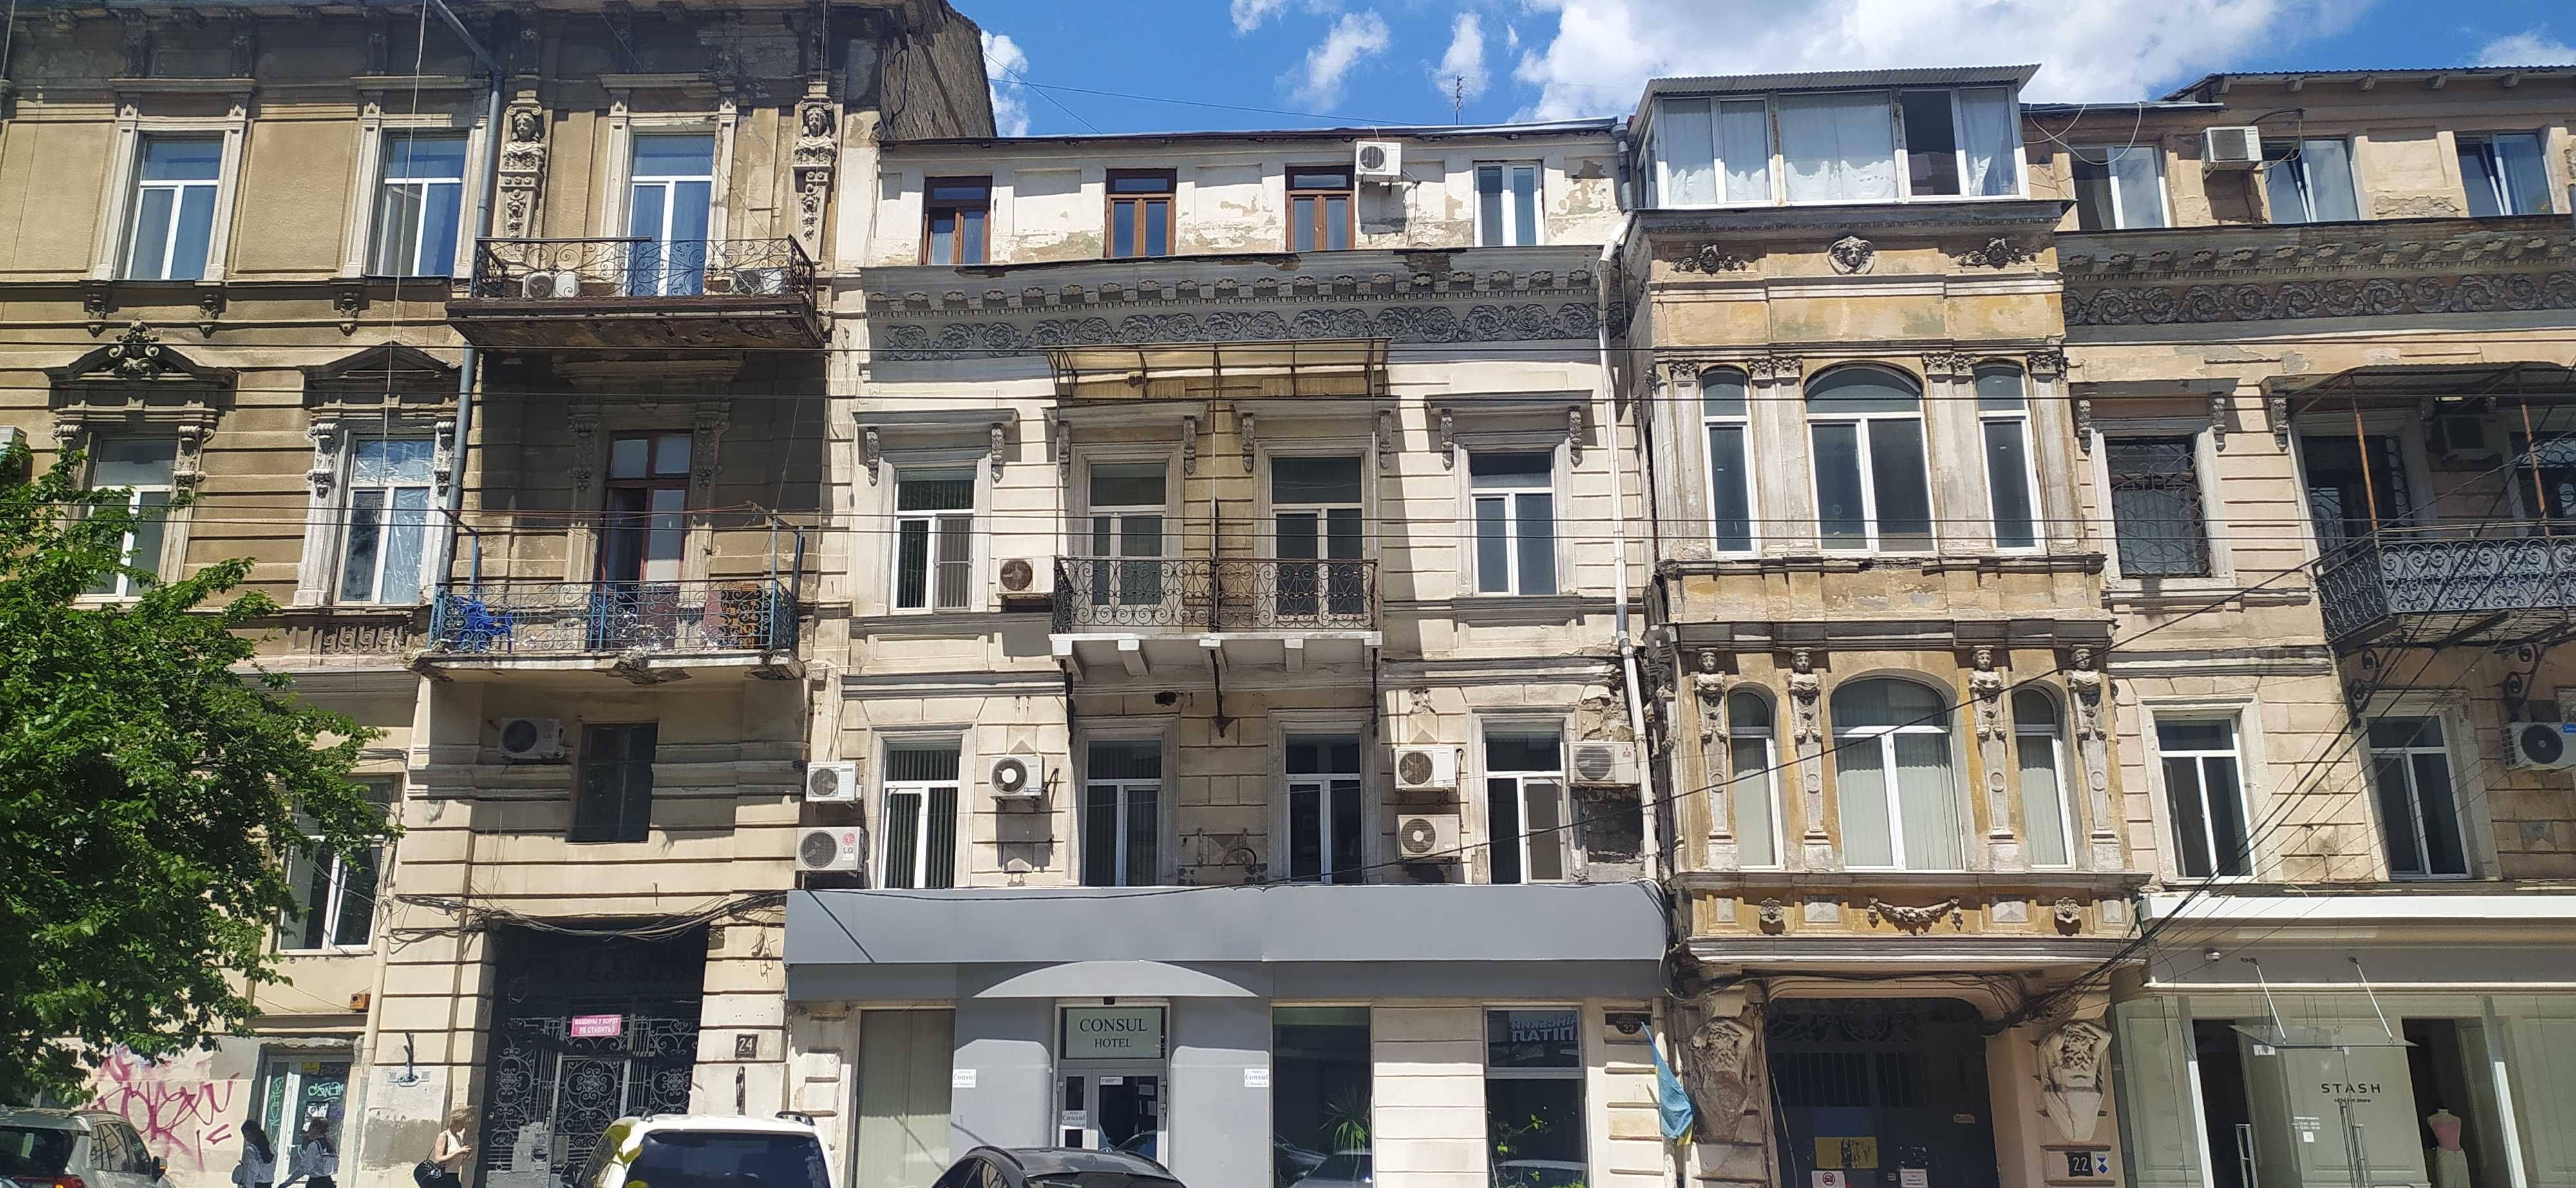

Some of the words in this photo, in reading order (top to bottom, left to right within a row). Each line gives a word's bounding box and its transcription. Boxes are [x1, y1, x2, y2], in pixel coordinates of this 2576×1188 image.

[1079, 1019, 1148, 1032] CONSUL
[738, 1037, 753, 1051] 24
[1095, 1038, 1132, 1048] HOTEL
[2321, 1083, 2381, 1094] STASH
[2073, 1156, 2088, 1171] 22
